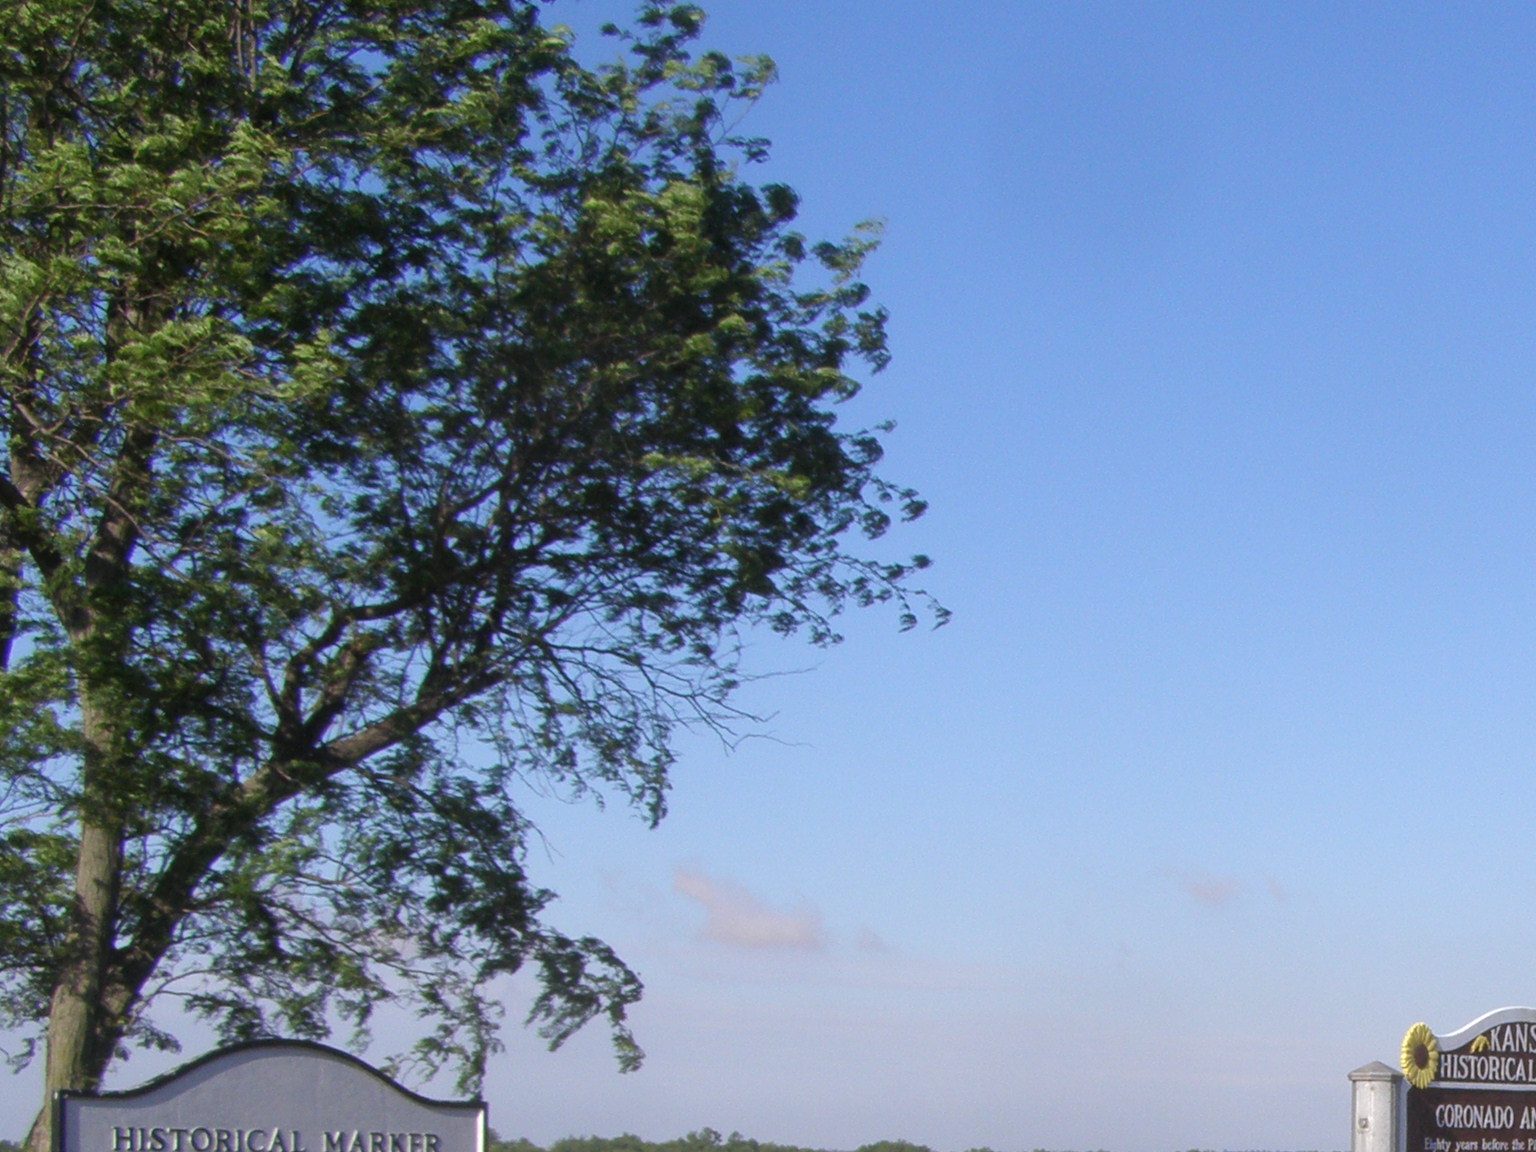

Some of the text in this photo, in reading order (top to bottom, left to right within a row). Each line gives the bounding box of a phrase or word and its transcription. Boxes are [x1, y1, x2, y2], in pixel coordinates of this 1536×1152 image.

[1436, 1104, 1513, 1129] CORONADO
[1424, 1137, 1451, 1152] Eighty
[1455, 1141, 1478, 1152] years
[1482, 1138, 1509, 1150] before
[1512, 1139, 1525, 1150] the
